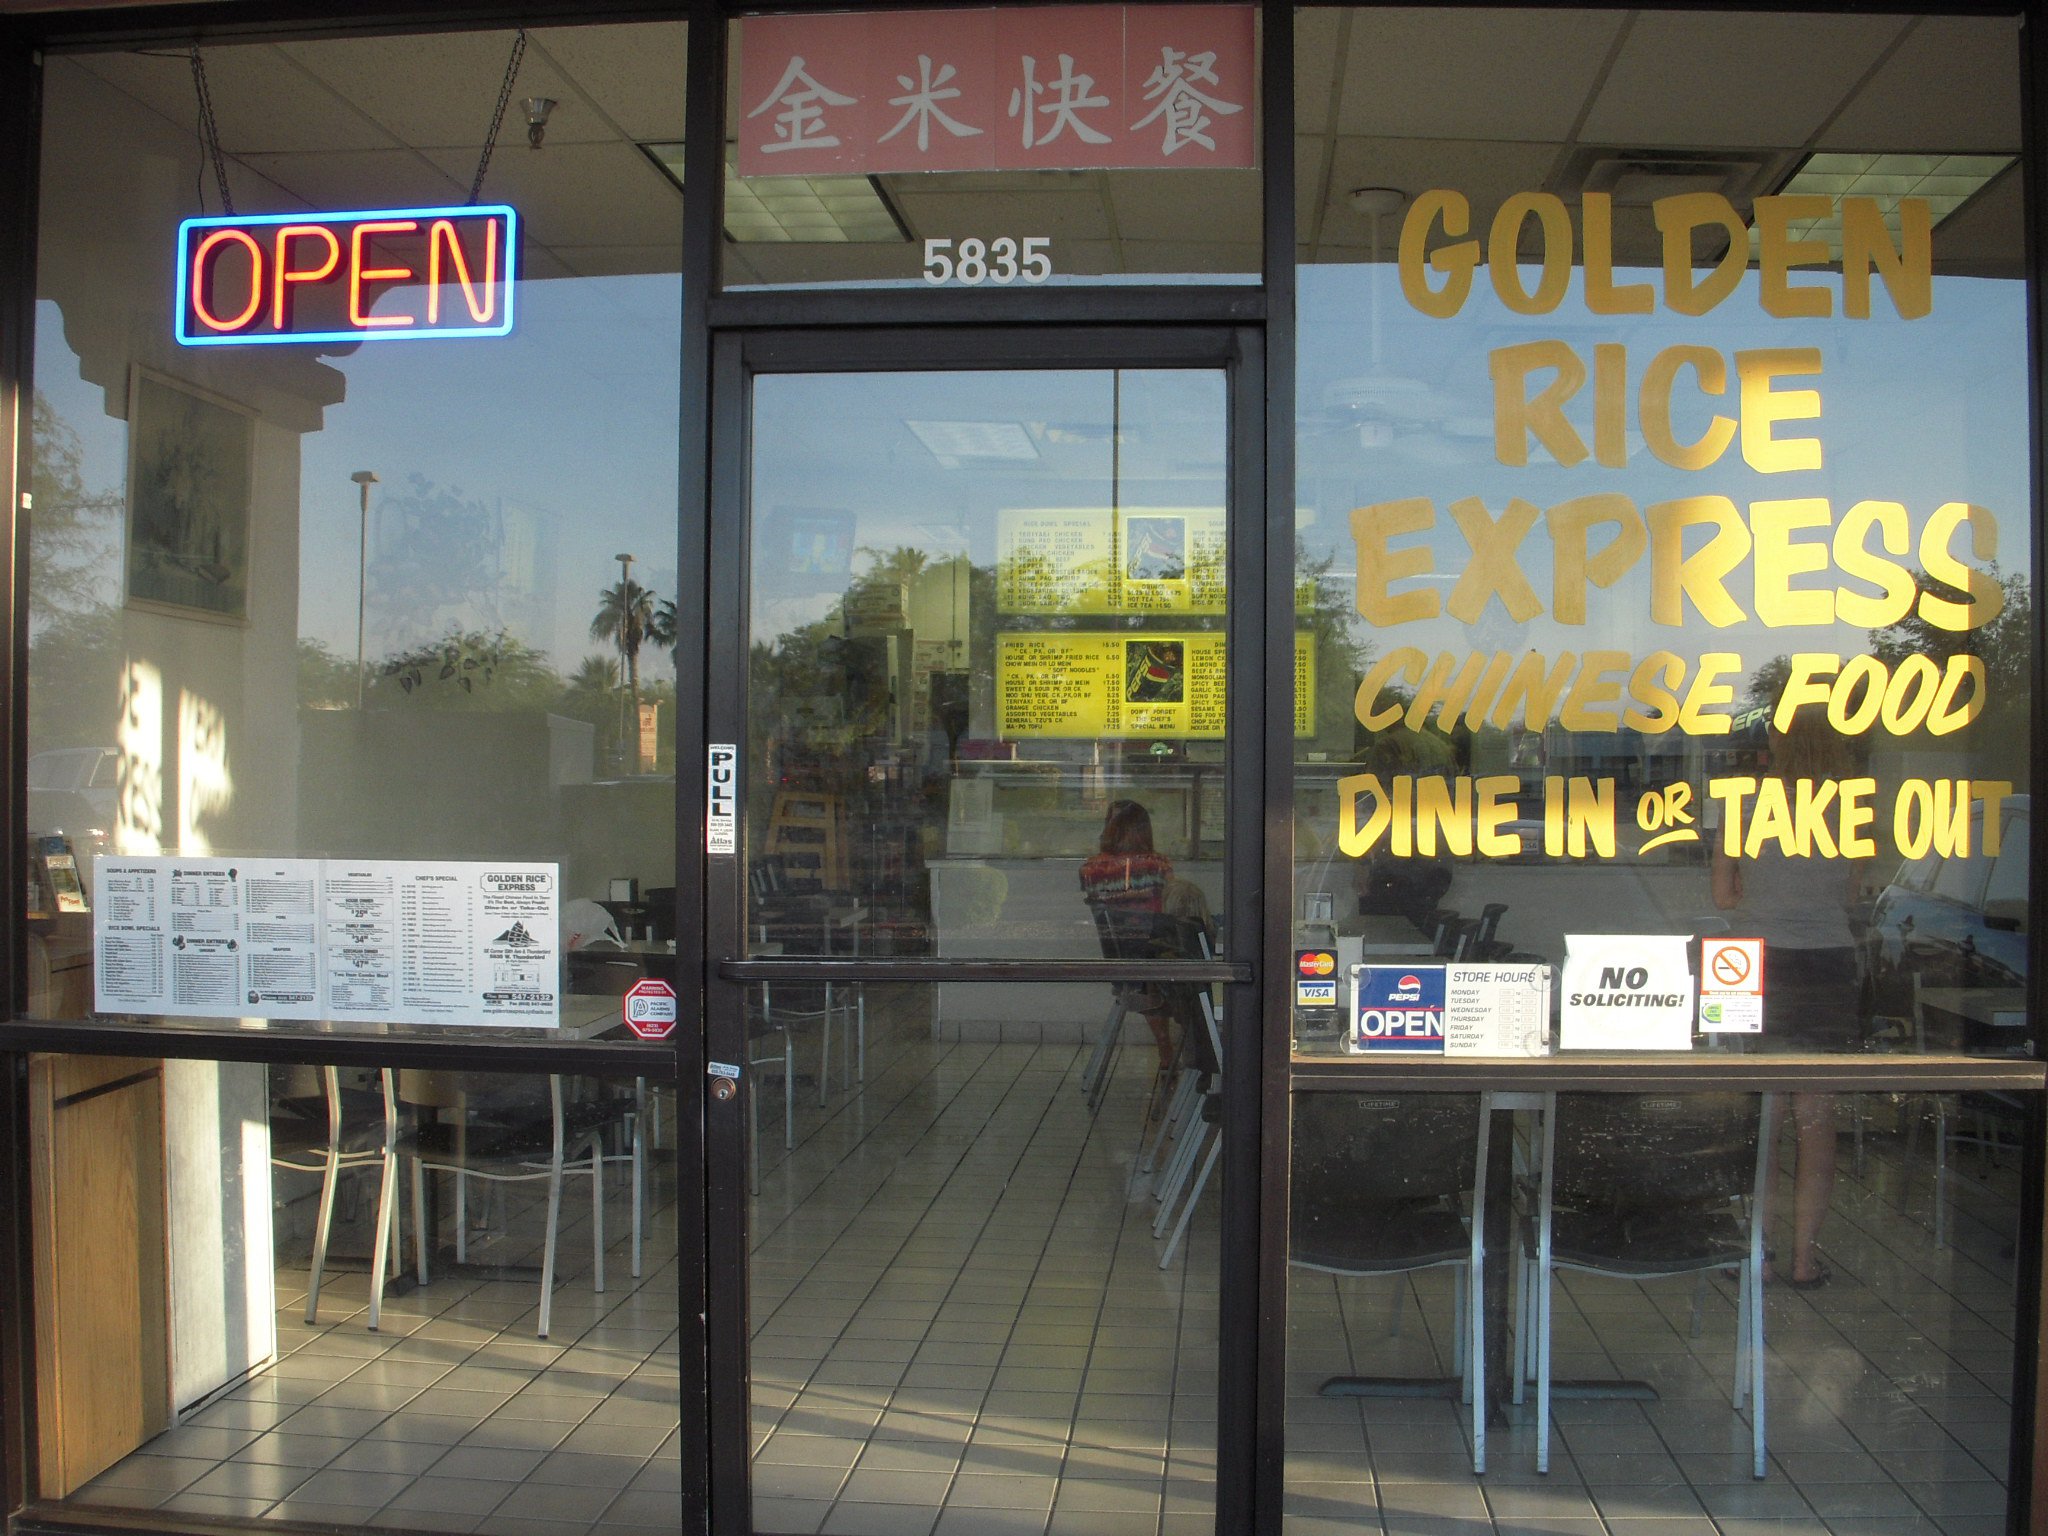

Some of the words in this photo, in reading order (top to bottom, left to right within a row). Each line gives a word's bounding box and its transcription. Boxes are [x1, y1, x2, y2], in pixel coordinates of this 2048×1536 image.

[747, 46, 1244, 156] 金米快餐
[192, 217, 498, 332] OPEN
[922, 236, 1052, 285] 5835
[1399, 189, 1932, 320] GOLDEN
[1488, 339, 1823, 473] RICE
[1348, 492, 2004, 631] EXPRESS
[1126, 655, 1151, 702] PEPSI
[1354, 646, 1742, 735] CHINESE
[1773, 652, 1986, 736] FOOD
[711, 752, 733, 817] PULL
[1336, 773, 1522, 858] DINE
[1543, 776, 1616, 858] IN
[1635, 780, 1697, 834] OR
[1708, 777, 1876, 858] TAKE
[1892, 779, 2013, 858] OUT
[709, 835, 733, 844] Atlas
[487, 874, 523, 883] GOLDEN
[525, 875, 547, 883] RICE
[497, 883, 536, 891] EXPRESS
[1304, 988, 1329, 998] VISA
[1388, 993, 1420, 1002] PEPSI
[1453, 971, 1491, 983] STORE
[1494, 971, 1536, 983] HOURS
[1569, 993, 1685, 1008] SOLICITING!
[1598, 966, 1649, 990] NO
[1360, 1010, 1445, 1037] OPEN
